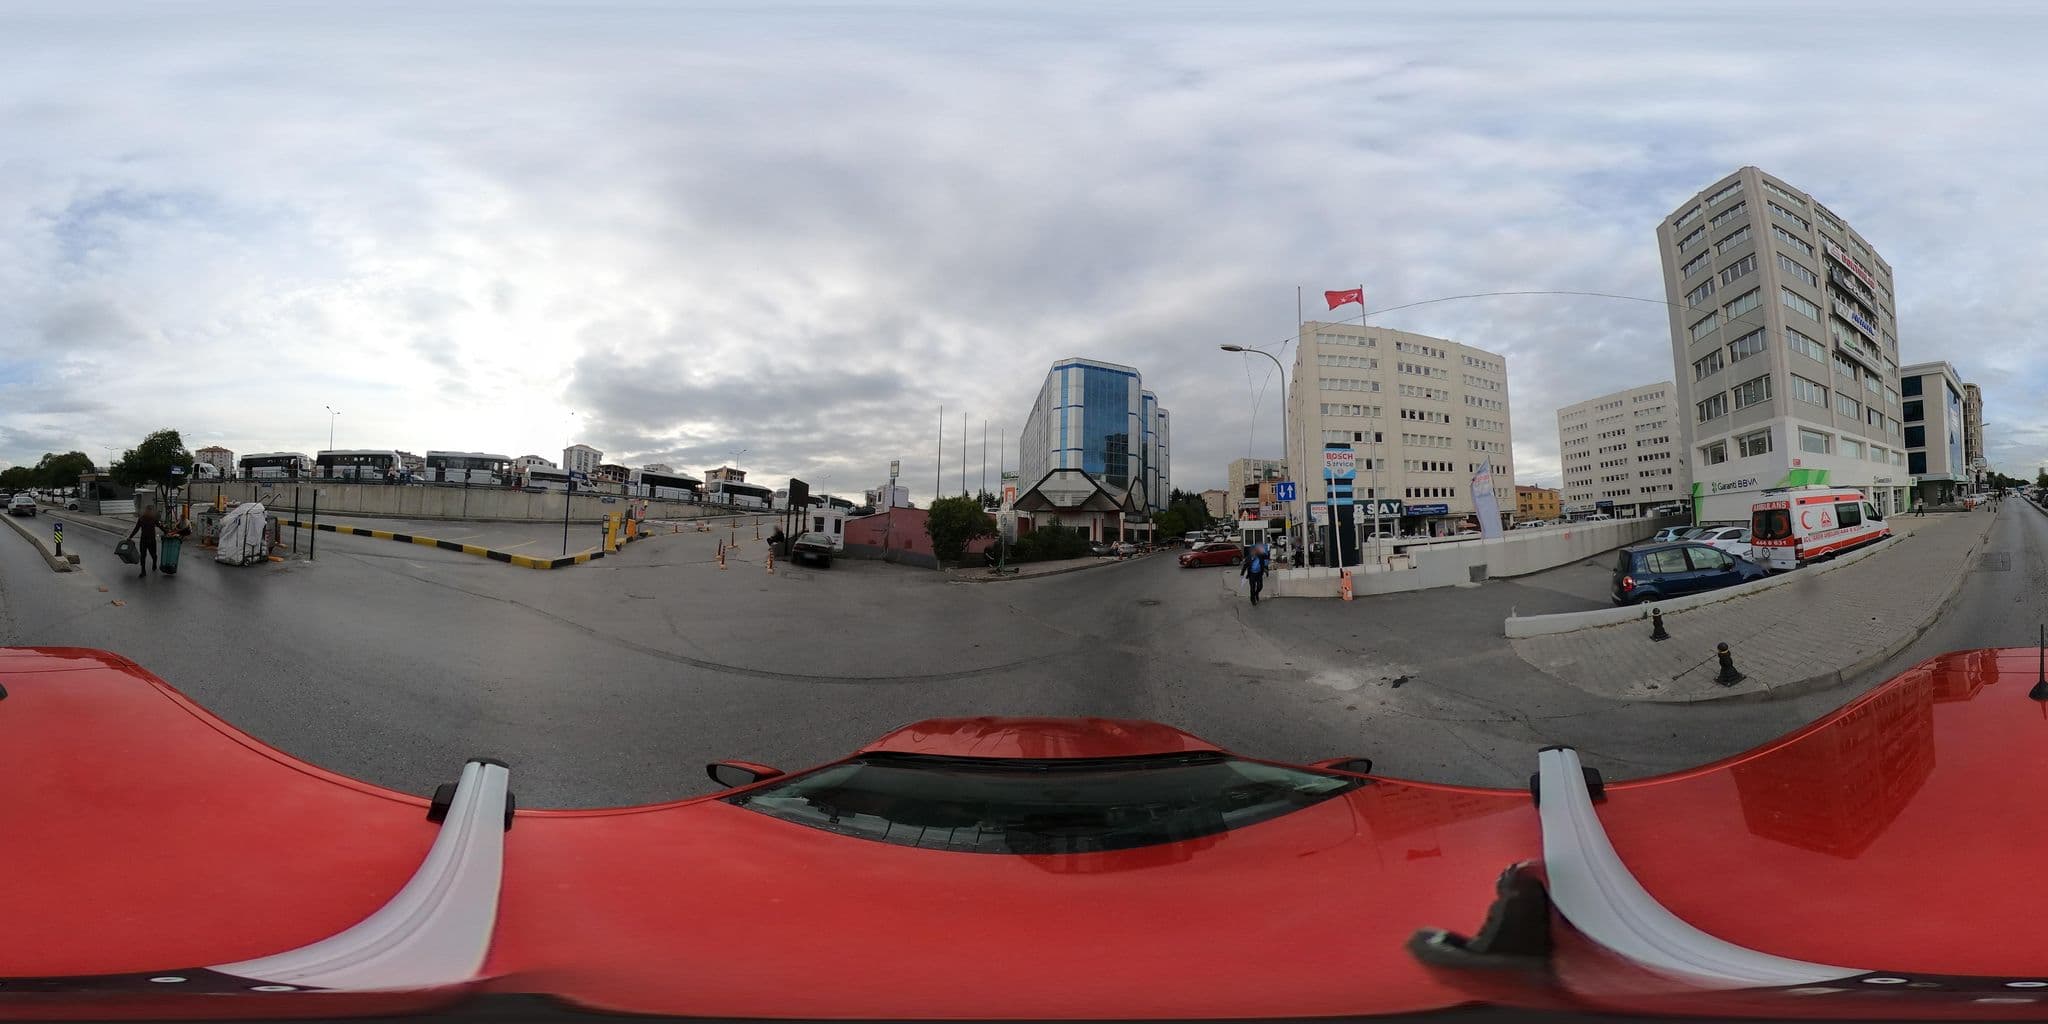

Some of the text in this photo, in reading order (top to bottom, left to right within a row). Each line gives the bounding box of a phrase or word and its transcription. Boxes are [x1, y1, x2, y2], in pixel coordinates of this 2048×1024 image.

[1717, 477, 1758, 491] Garanti BBVA
[1753, 501, 1787, 511] AMBULANS
